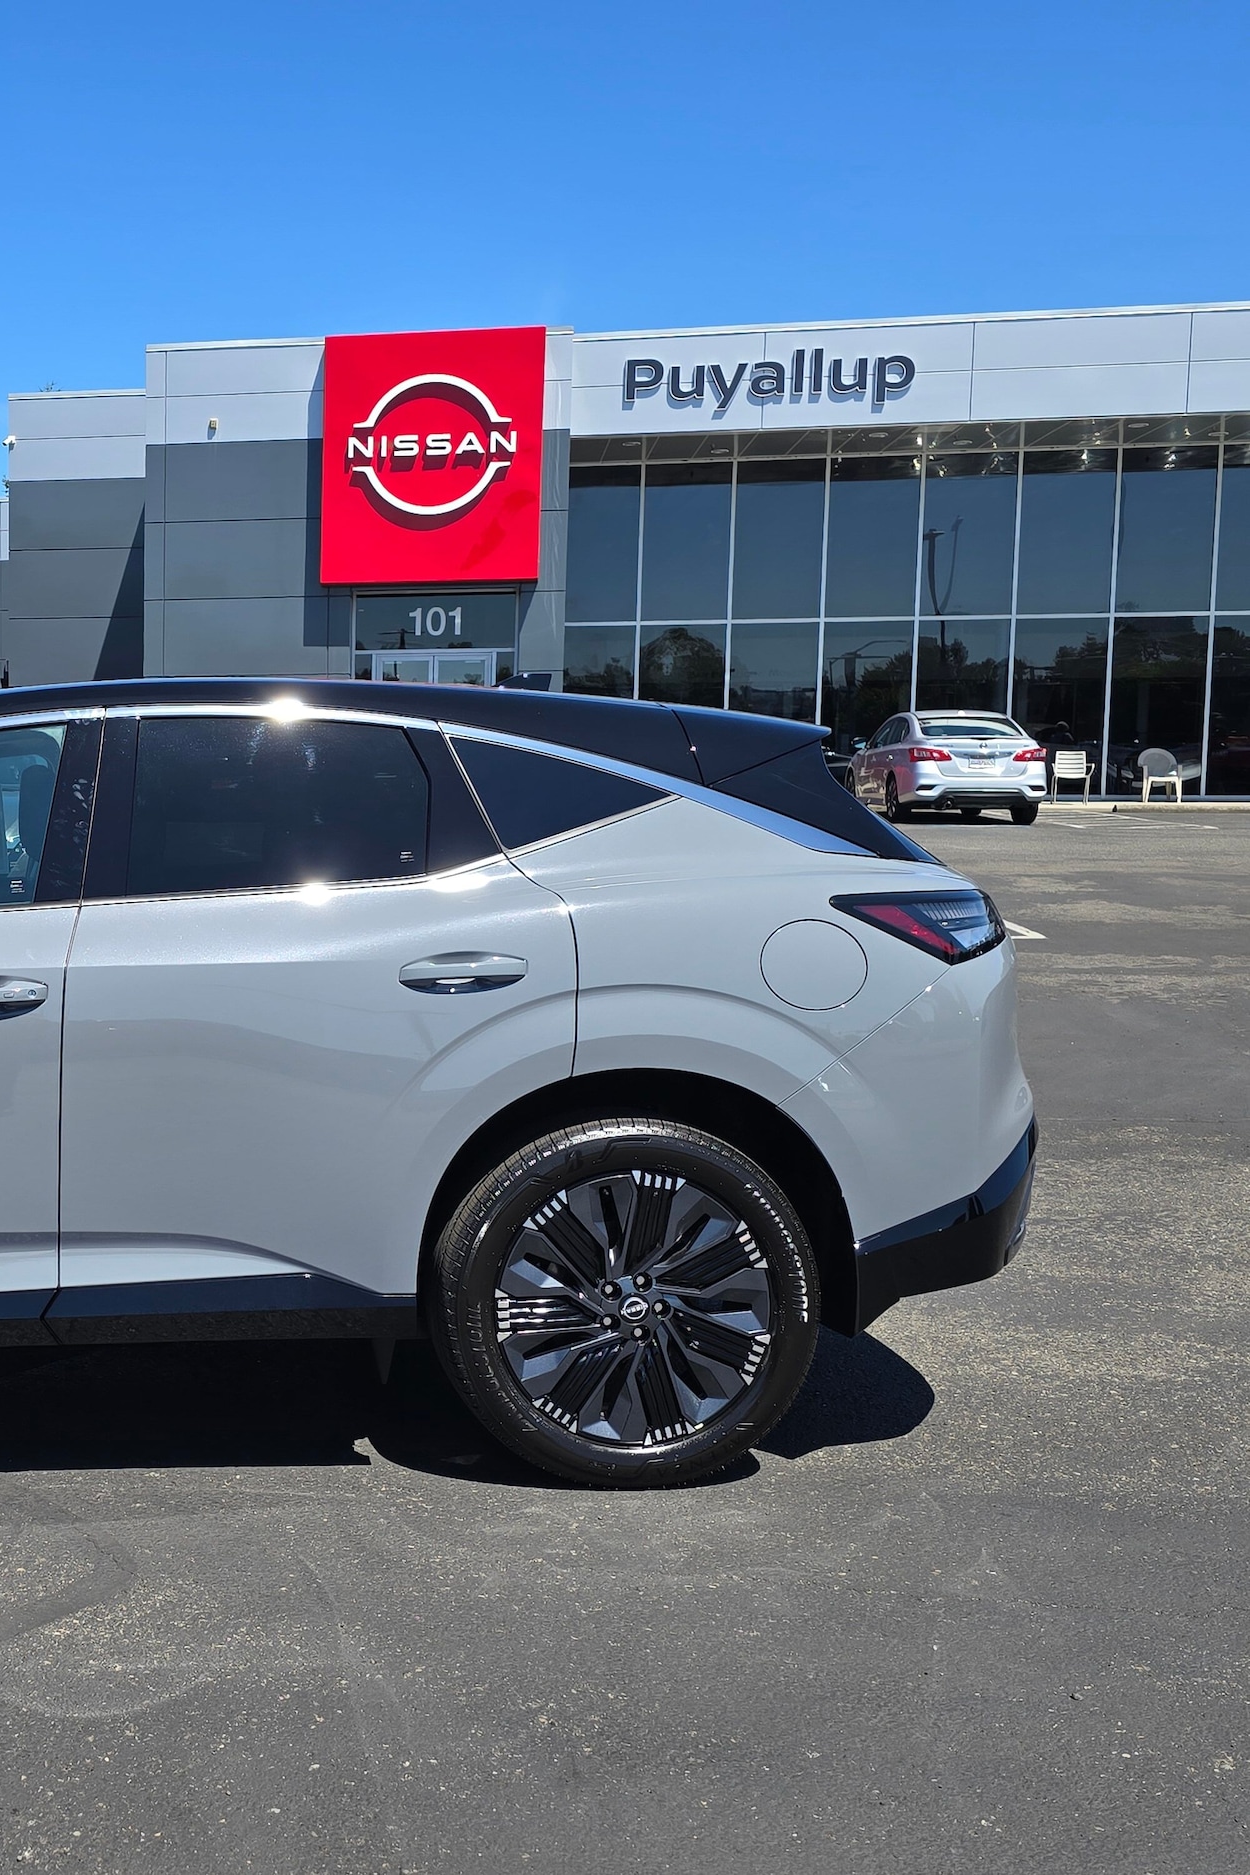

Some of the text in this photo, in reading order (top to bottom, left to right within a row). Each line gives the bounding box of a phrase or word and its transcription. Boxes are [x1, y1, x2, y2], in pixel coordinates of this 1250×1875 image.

[625, 347, 916, 410] Puyallup
[348, 431, 517, 458] NISSAN
[409, 607, 462, 636] 101
